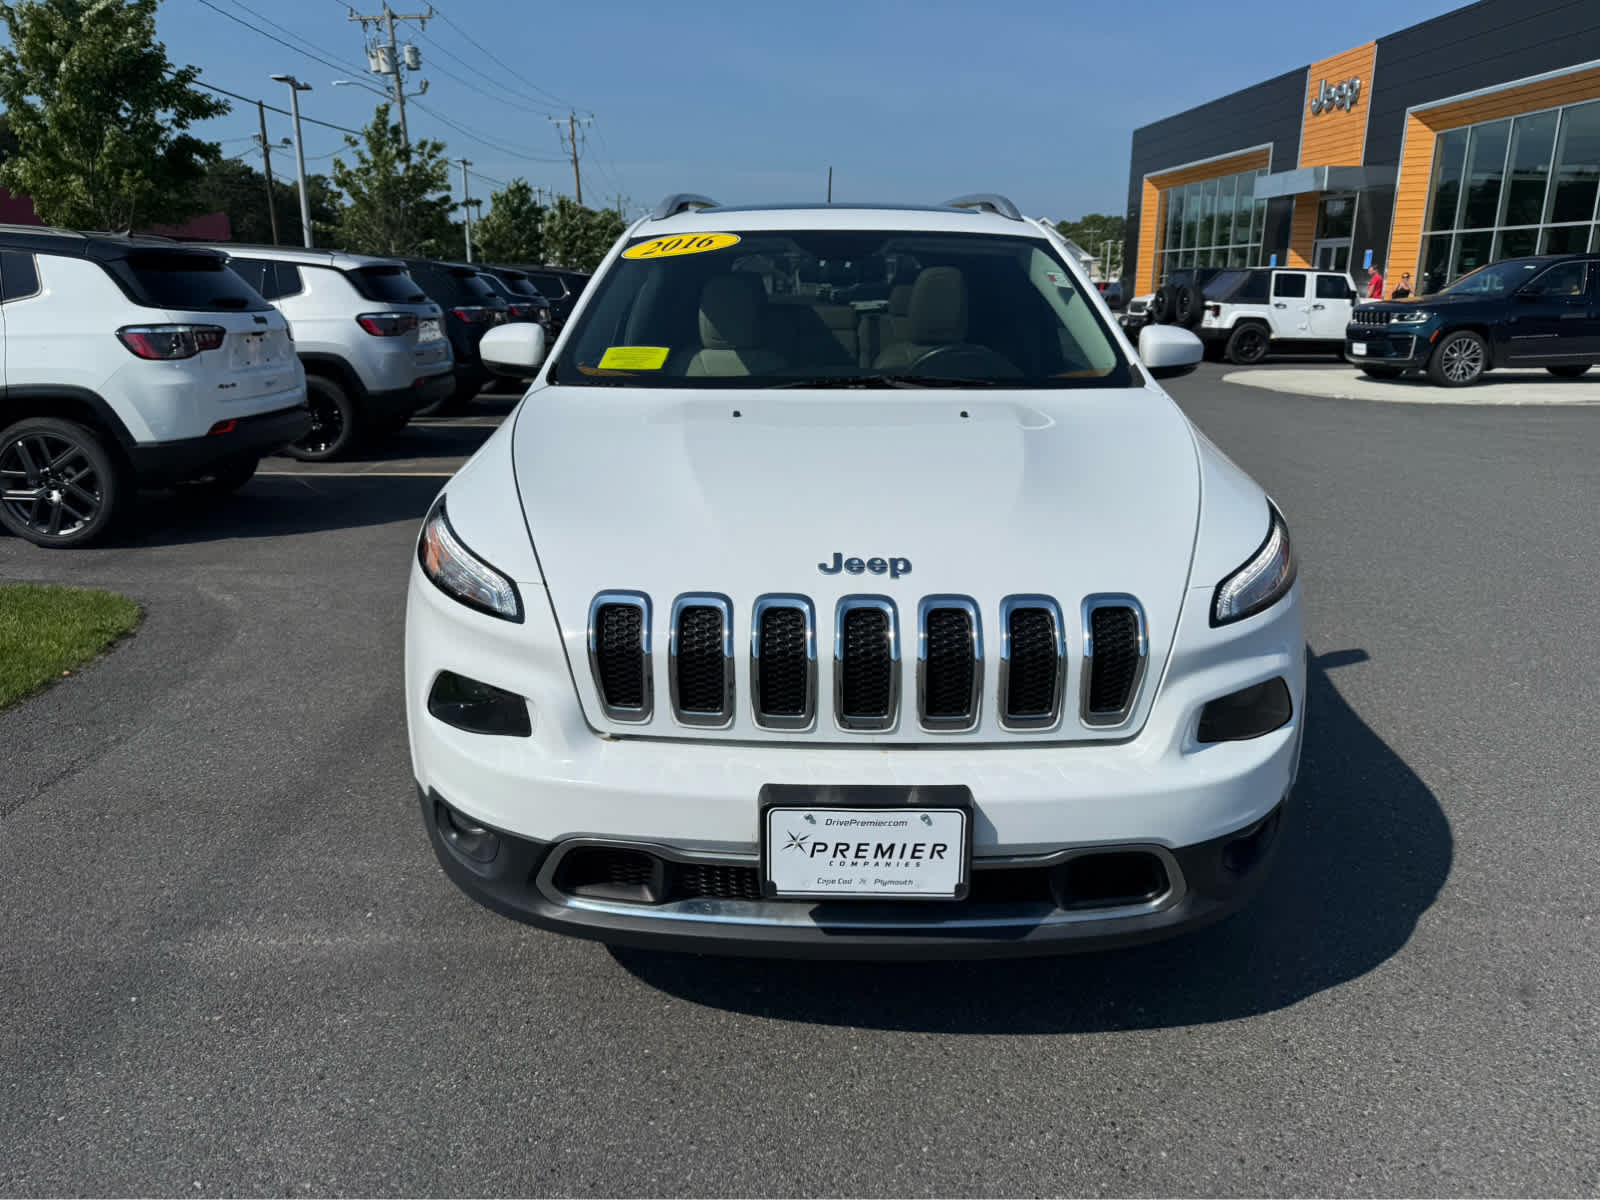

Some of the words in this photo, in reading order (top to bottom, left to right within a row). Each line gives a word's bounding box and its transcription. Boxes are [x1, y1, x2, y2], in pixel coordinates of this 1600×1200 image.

[1311, 76, 1361, 116] Jeep
[641, 236, 717, 255] 2016
[818, 552, 912, 579] Jeep
[810, 842, 948, 860] PREMIER
[817, 877, 836, 886] Cape
[874, 878, 914, 887] Plymouth
